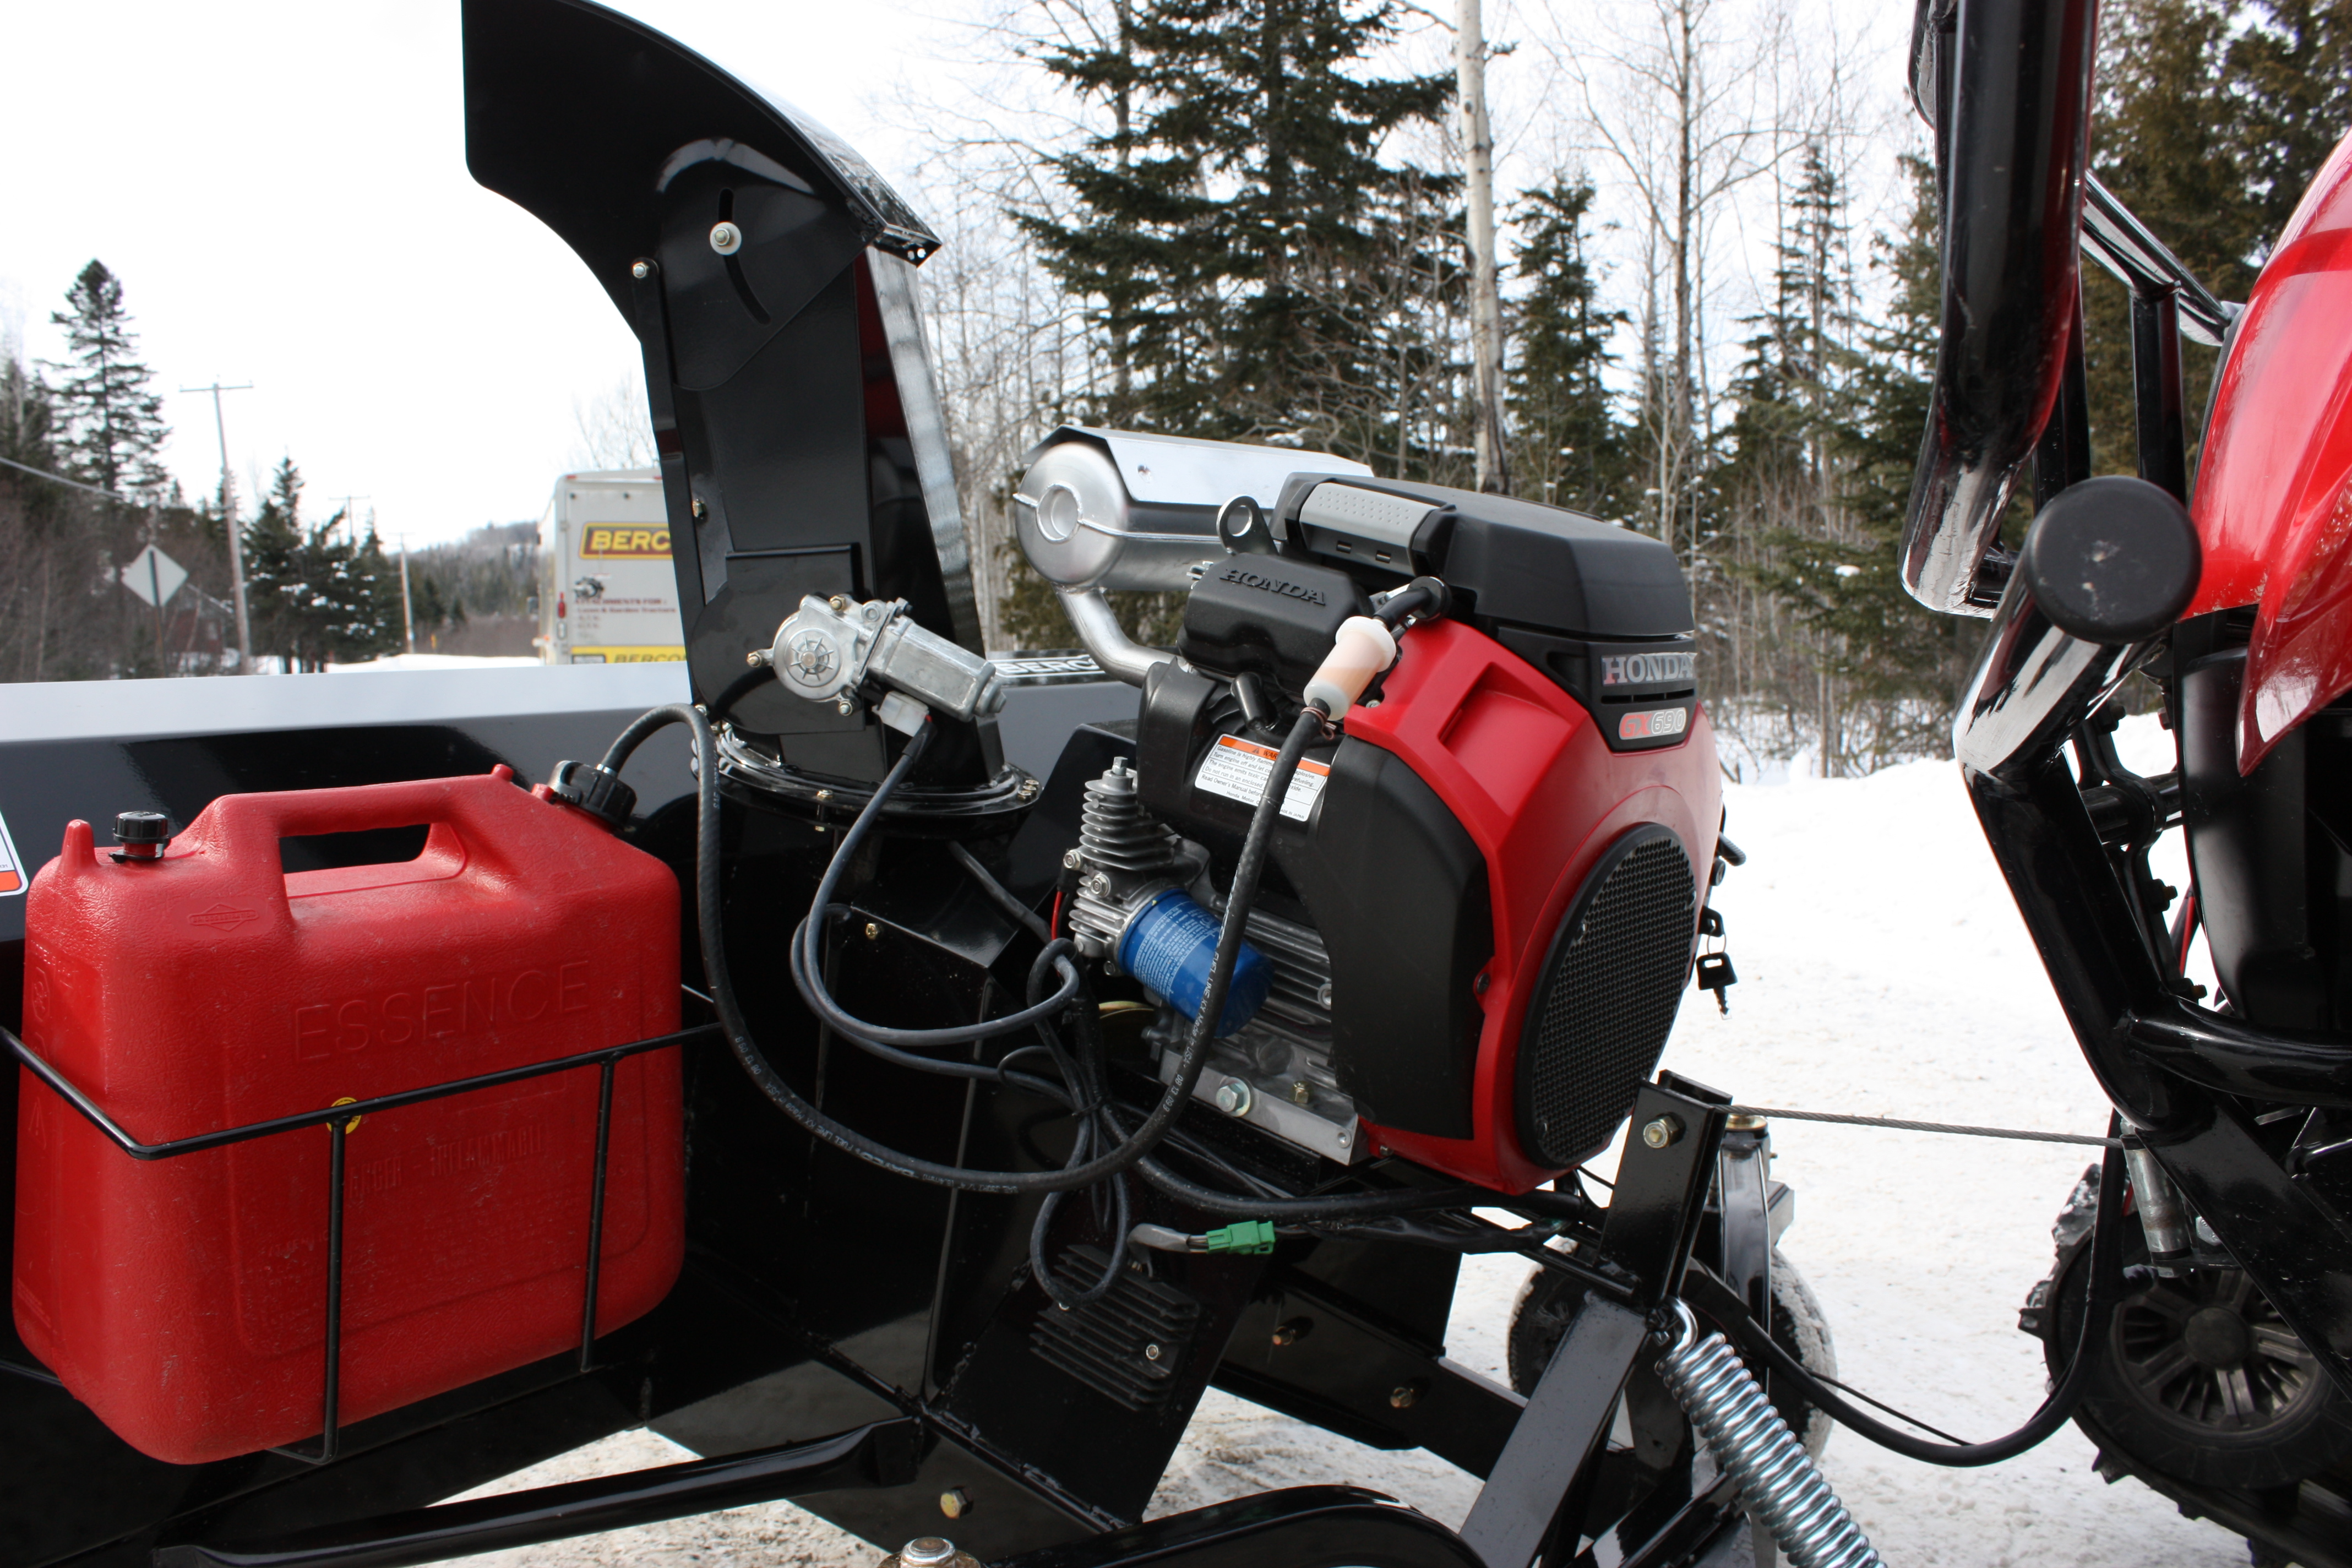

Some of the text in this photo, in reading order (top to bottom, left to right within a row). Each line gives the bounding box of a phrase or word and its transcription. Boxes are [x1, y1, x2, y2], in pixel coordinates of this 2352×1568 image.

[1219, 569, 1326, 606] HONDA
[1602, 655, 1695, 684] HONDA
[1620, 709, 1686, 738] GX690
[1217, 746, 1237, 755] Gasoline
[1242, 753, 1256, 761] highly
[1224, 755, 1239, 764] engine
[1218, 763, 1234, 771] engine
[1201, 774, 1213, 782] Read
[1214, 777, 1231, 787] Owner's
[1231, 783, 1249, 793] Manual
[1242, 777, 1263, 788] enclosed
[1211, 953, 1219, 973] FUEL
[1204, 977, 1212, 998] LINE
[295, 960, 591, 1065] ESSENCE
[1192, 1012, 1204, 1038] Made
[765, 1081, 780, 1097] USA
[786, 1103, 805, 1120] Made
[816, 1125, 834, 1140] LINE
[835, 1135, 854, 1152] FUEL
